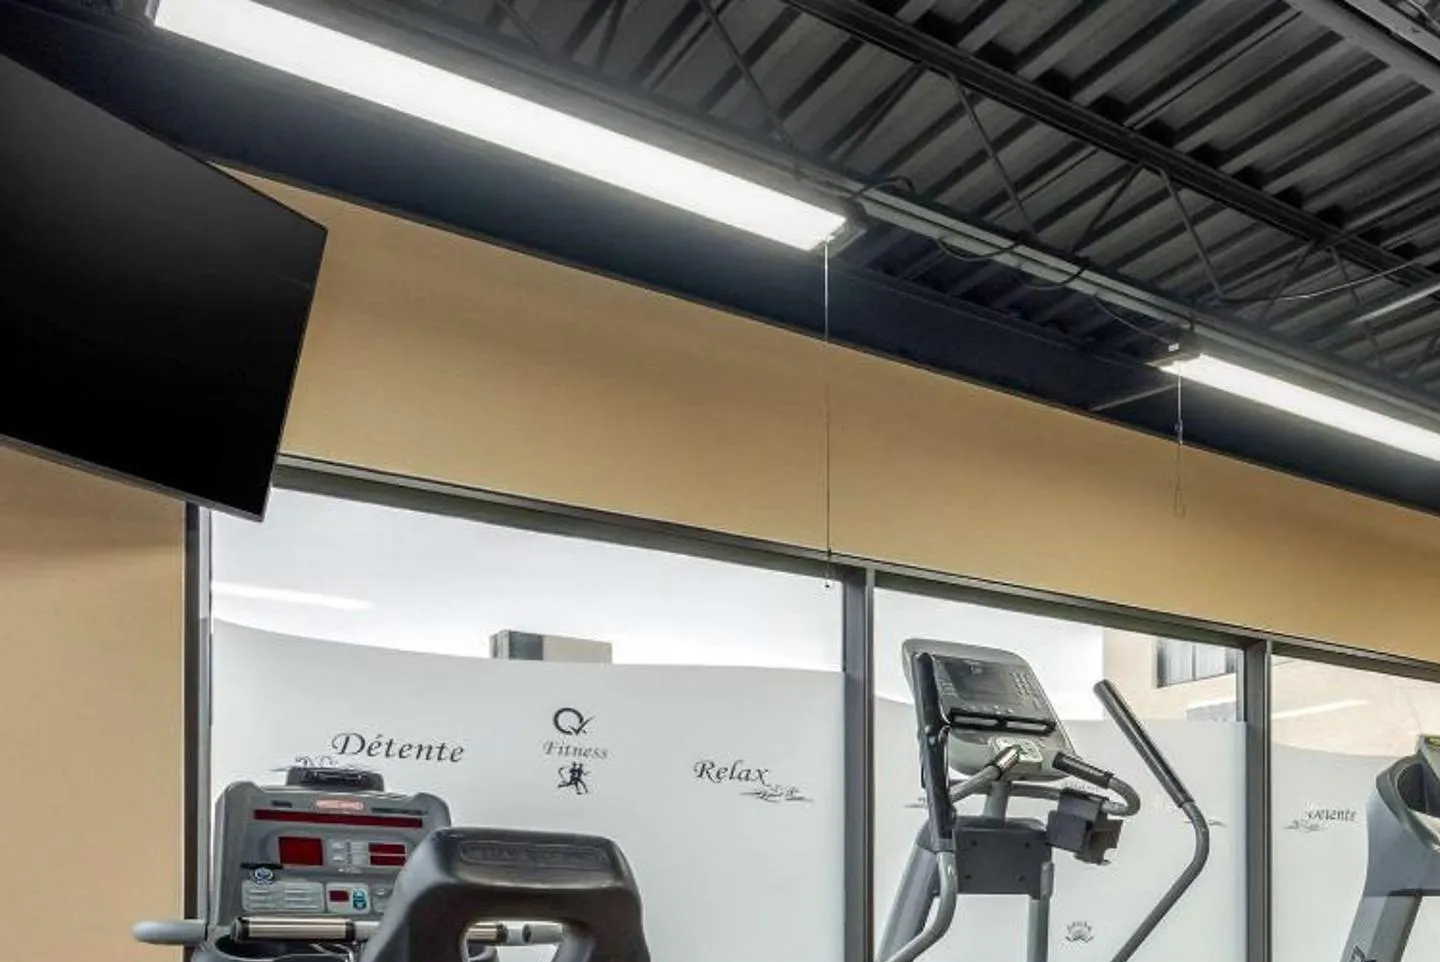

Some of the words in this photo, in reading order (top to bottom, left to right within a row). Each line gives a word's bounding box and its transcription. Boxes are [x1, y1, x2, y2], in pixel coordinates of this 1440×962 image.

[331, 732, 464, 763] Détente
[542, 740, 609, 760] Fitness
[693, 759, 771, 787] Relax
